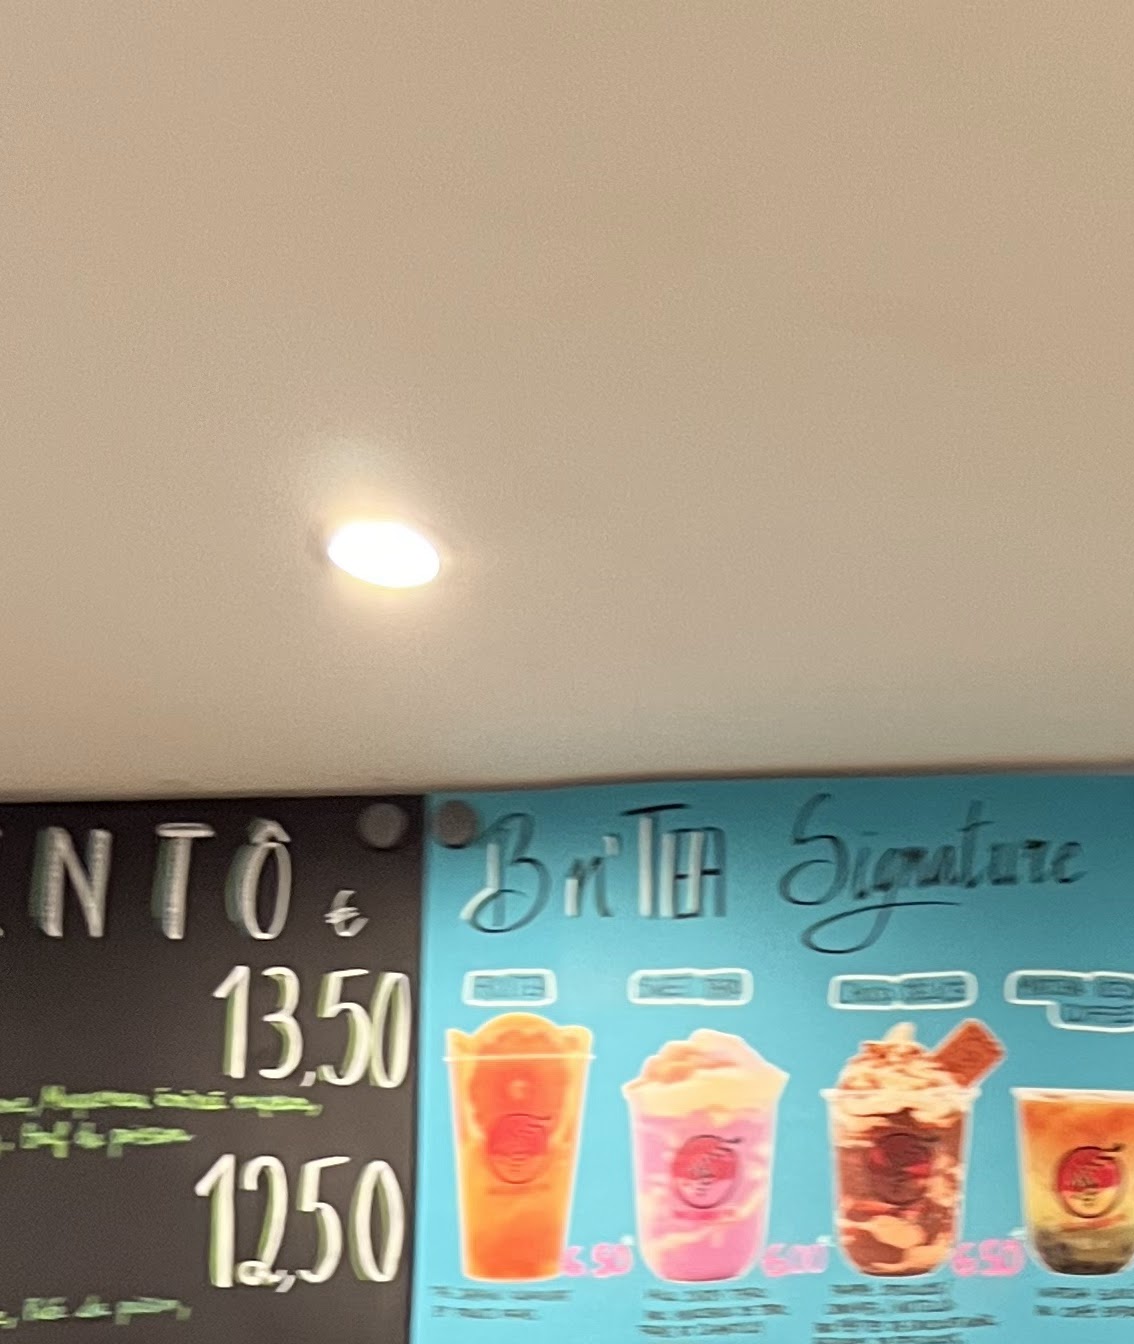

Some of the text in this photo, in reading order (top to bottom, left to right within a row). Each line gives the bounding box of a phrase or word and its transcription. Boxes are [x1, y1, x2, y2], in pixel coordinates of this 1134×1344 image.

[778, 793, 1088, 954] Signature
[212, 965, 412, 1088] 13,50
[194, 1153, 405, 1292] 12,50
